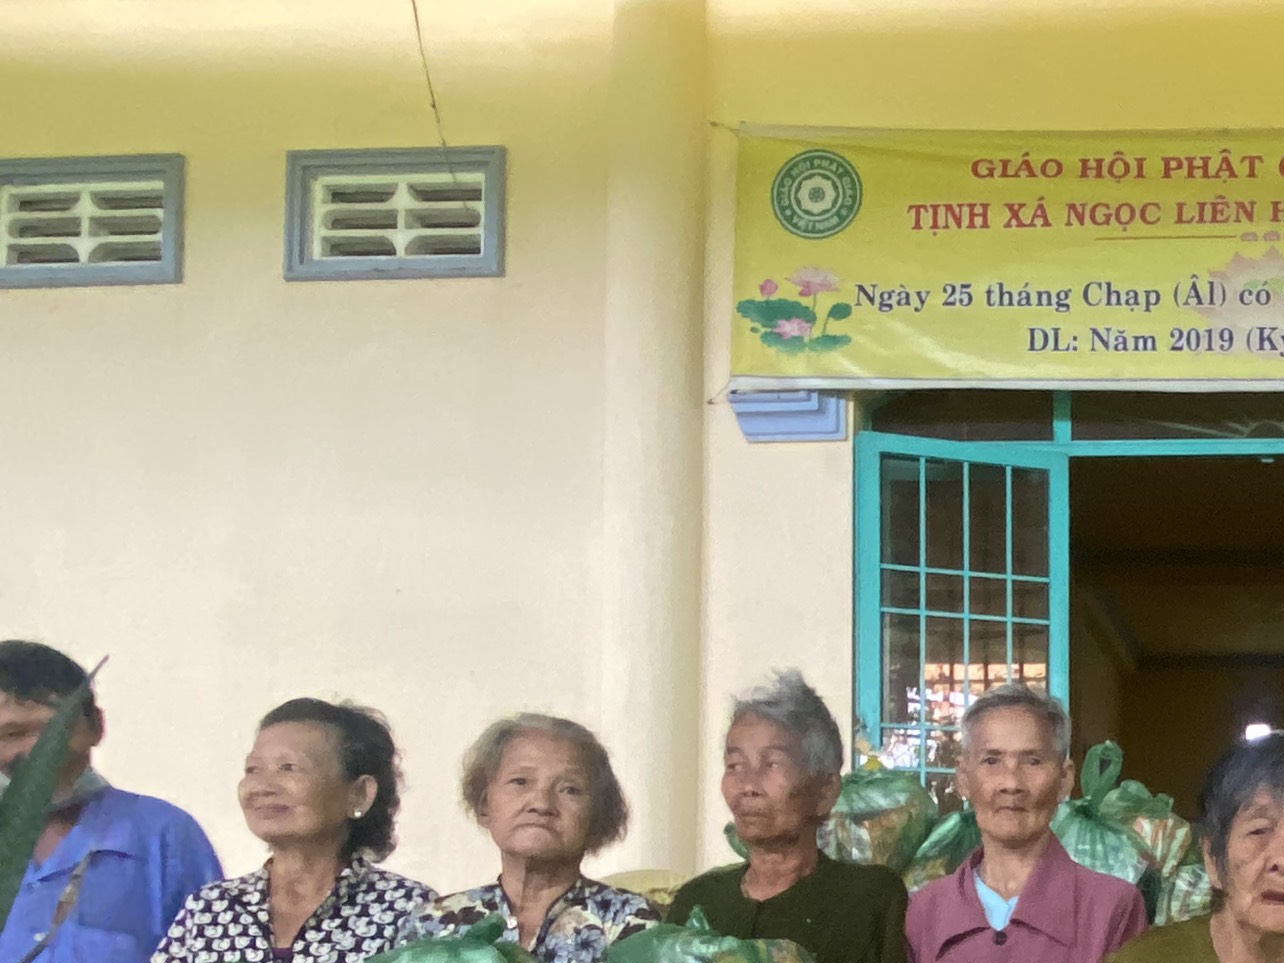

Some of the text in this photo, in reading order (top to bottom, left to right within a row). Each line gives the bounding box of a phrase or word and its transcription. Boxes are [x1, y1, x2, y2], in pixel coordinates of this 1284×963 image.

[971, 151, 1063, 179] GIÁO
[1079, 151, 1147, 183] HỘI
[1160, 149, 1264, 183] PHẬT
[907, 203, 990, 237] TỊNH
[1003, 196, 1051, 229] XÁ
[1065, 202, 1161, 231] NGỌC
[1174, 195, 1256, 225] LIÊN
[854, 284, 930, 312] Ngày
[942, 283, 973, 307] 25
[985, 281, 1072, 312] tháng
[1082, 281, 1161, 312] Chạp
[1239, 281, 1271, 305] có
[1027, 327, 1078, 352] DL:
[1090, 327, 1157, 352] Năm
[1169, 327, 1234, 352] 2019
